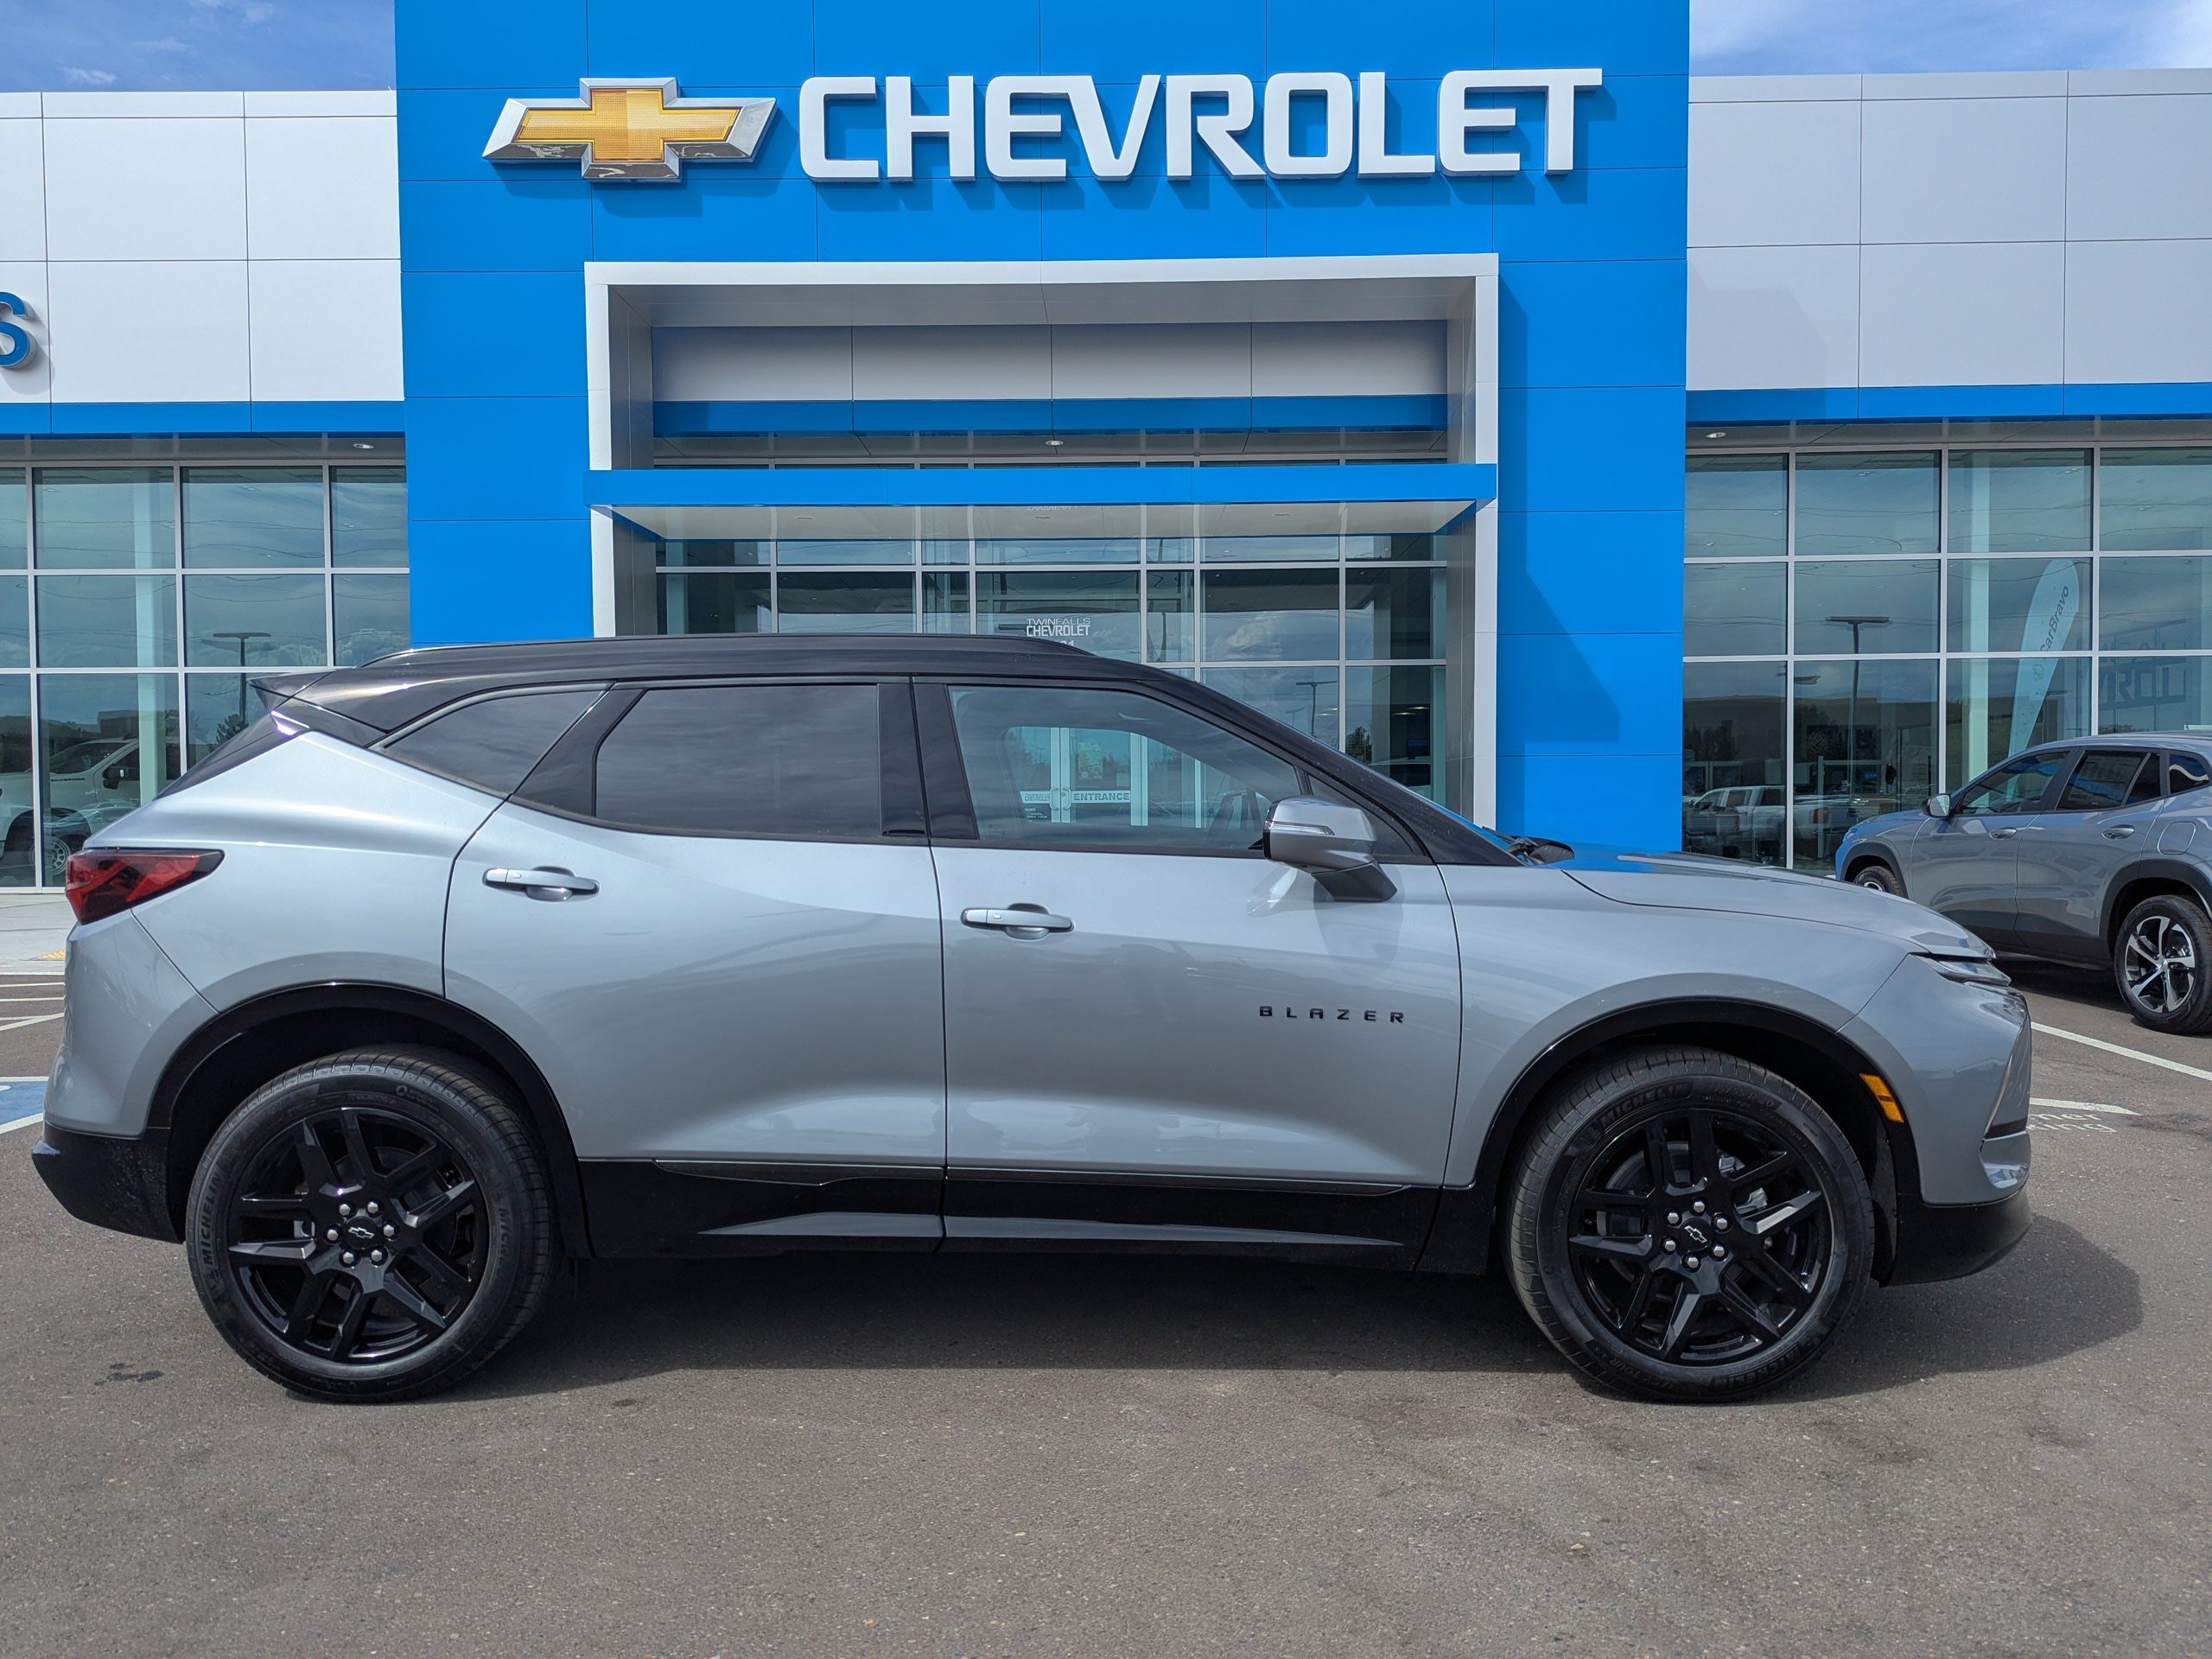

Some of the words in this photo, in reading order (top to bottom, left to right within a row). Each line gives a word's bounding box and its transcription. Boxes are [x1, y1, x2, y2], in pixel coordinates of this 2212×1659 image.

[799, 68, 1603, 182] CHEVROLET
[1026, 625, 1090, 637] CHEVROLET
[1073, 792, 1130, 801] ENTRANCE
[1259, 1005, 1404, 1023] BLAZER
[200, 1173, 223, 1266] MICHELIN
